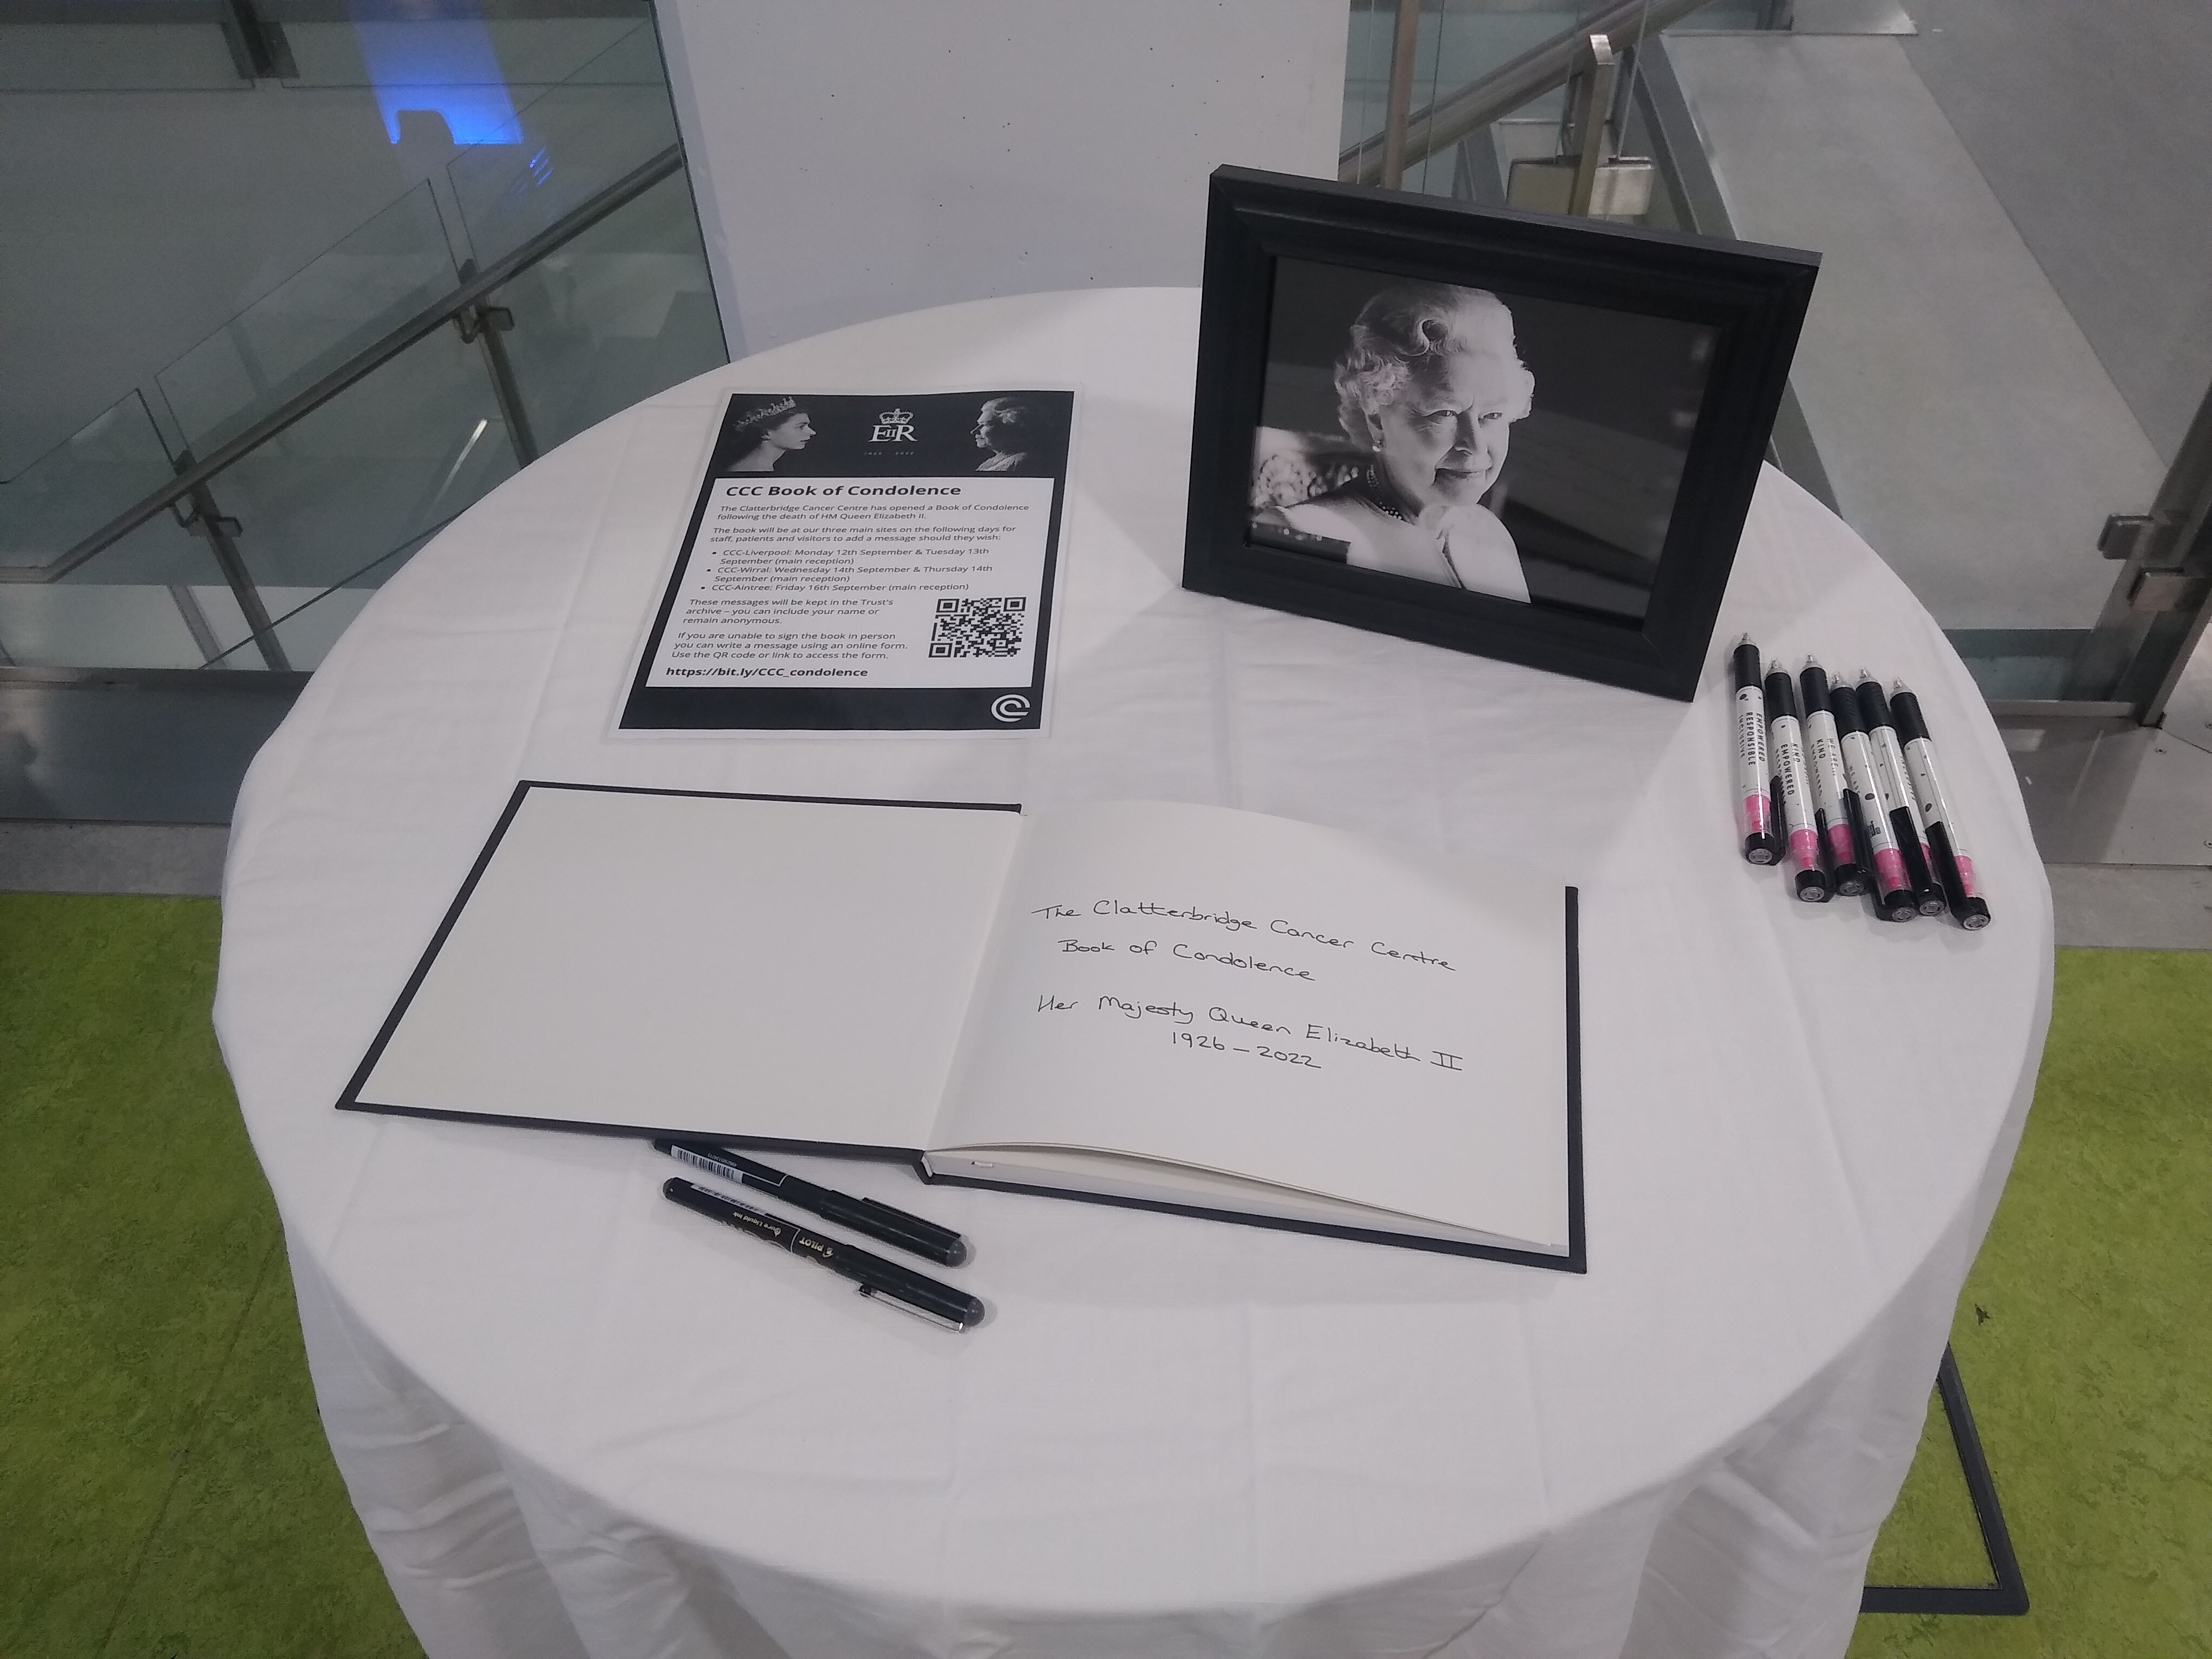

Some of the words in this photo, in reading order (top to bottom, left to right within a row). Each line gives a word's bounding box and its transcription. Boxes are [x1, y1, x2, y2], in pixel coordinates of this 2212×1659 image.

[726, 486, 763, 496] CCC
[768, 486, 818, 496] Book
[822, 486, 844, 496] of
[848, 485, 961, 495] Condolence
[832, 584, 886, 592] September
[889, 584, 916, 592] (main
[778, 632, 798, 640] sign
[801, 642, 828, 650] using
[713, 651, 728, 659] QR
[666, 667, 868, 678] https://bit.ly/CCC_condolence
[1746, 712, 1756, 766] RESPONSIBLE
[1756, 713, 1765, 761] EMPOWERED
[1791, 743, 1800, 762] KIND
[1816, 739, 1826, 759] KIND
[1781, 744, 1795, 795] EMPOWERED
[1031, 905, 1081, 920] The
[1093, 900, 1257, 930] Clatterbridge
[1270, 920, 1354, 948] Cancer
[1371, 942, 1455, 970] Centre
[1058, 939, 1115, 952] Book
[1130, 940, 1157, 954] of
[1173, 943, 1316, 981] Condolence
[1038, 995, 1078, 1011] Her
[1099, 996, 1193, 1023] Majesty
[1209, 1007, 1291, 1034] Queen
[1306, 1024, 1421, 1061] Elizabeth
[1431, 1051, 1462, 1071] II
[1172, 1031, 1225, 1051] 1926
[1257, 1046, 1321, 1069] 2022
[733, 1211, 743, 1219] Ink
[743, 1216, 763, 1227] Liquid
[799, 1237, 824, 1252] PILOT
